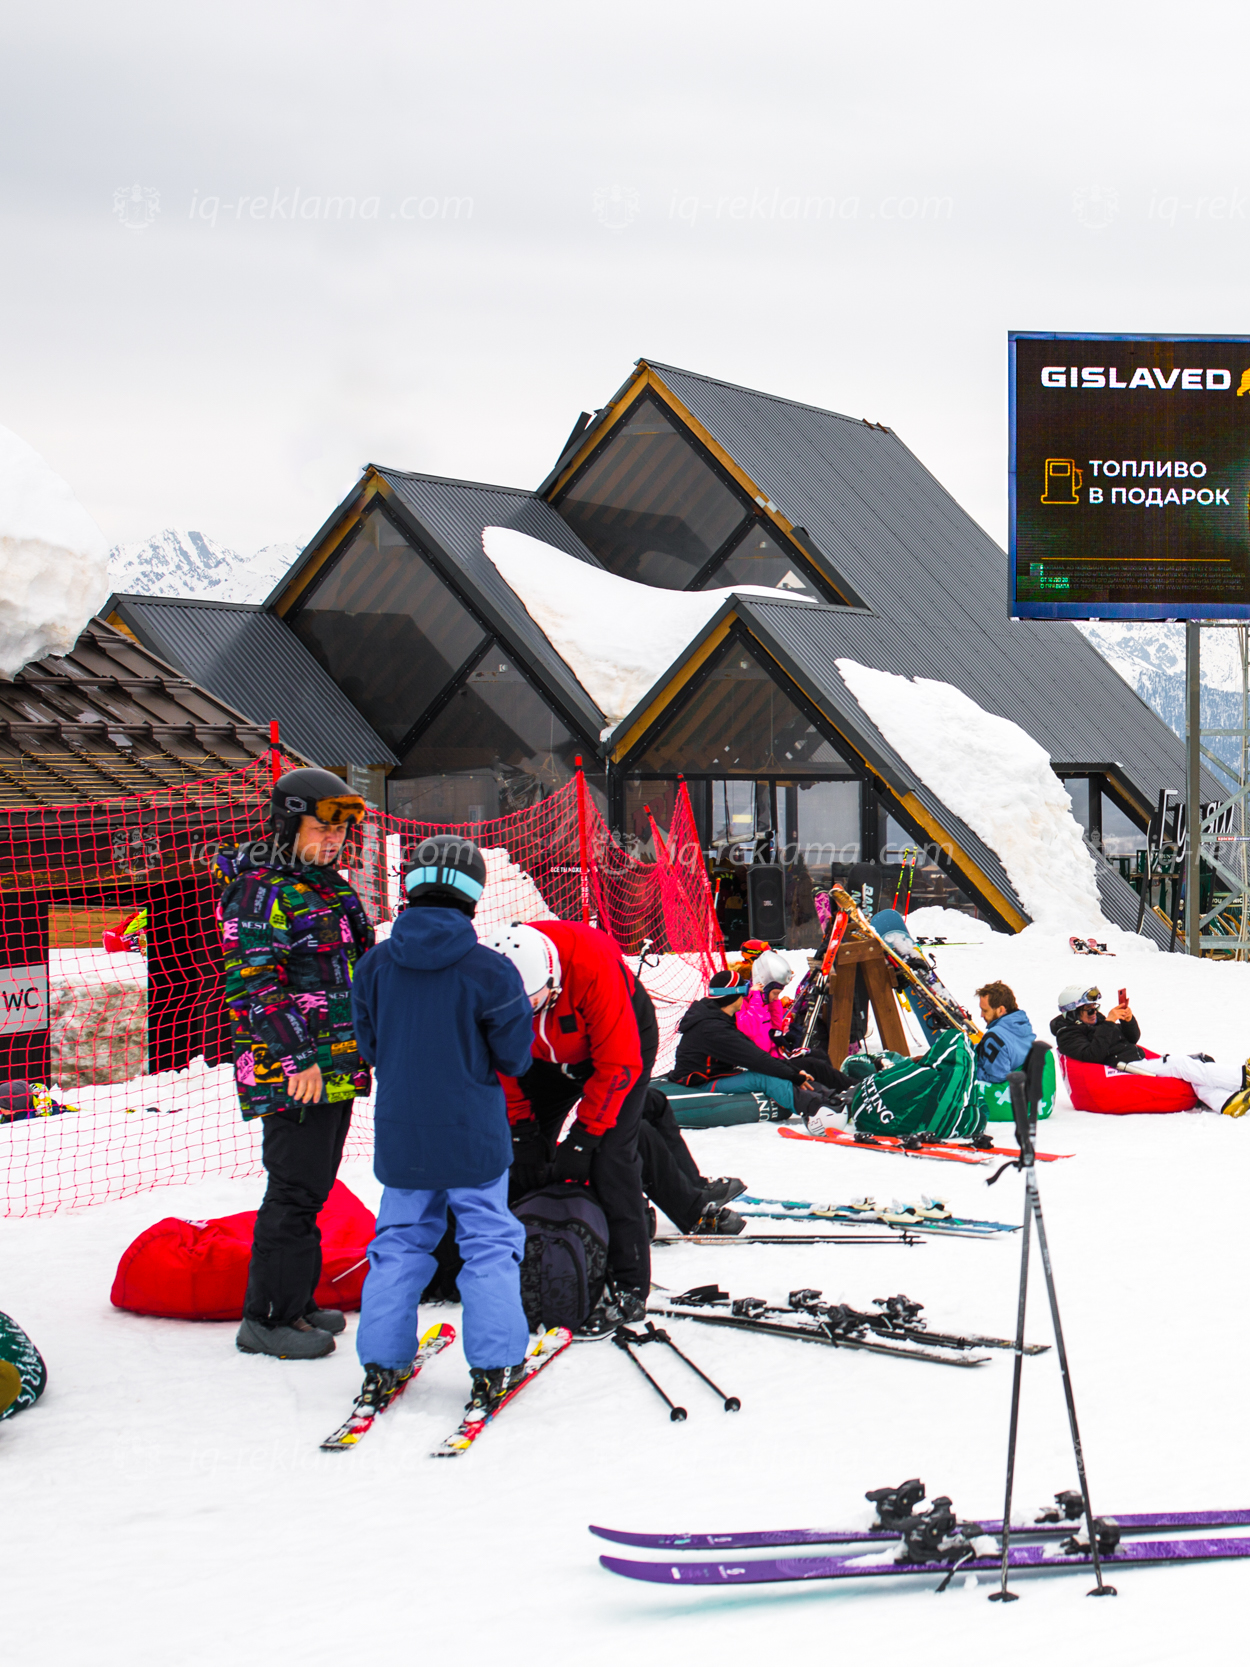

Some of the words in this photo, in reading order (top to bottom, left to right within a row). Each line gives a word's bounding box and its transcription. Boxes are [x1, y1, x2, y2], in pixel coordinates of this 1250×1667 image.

[1041, 366, 1231, 391] GISLAVED
[1089, 460, 1206, 478] ТОПЛИВО
[1089, 488, 1103, 504] В
[1111, 487, 1230, 507] ПОДАРОК
[241, 921, 268, 930] WEST
[2, 986, 39, 1013] WC
